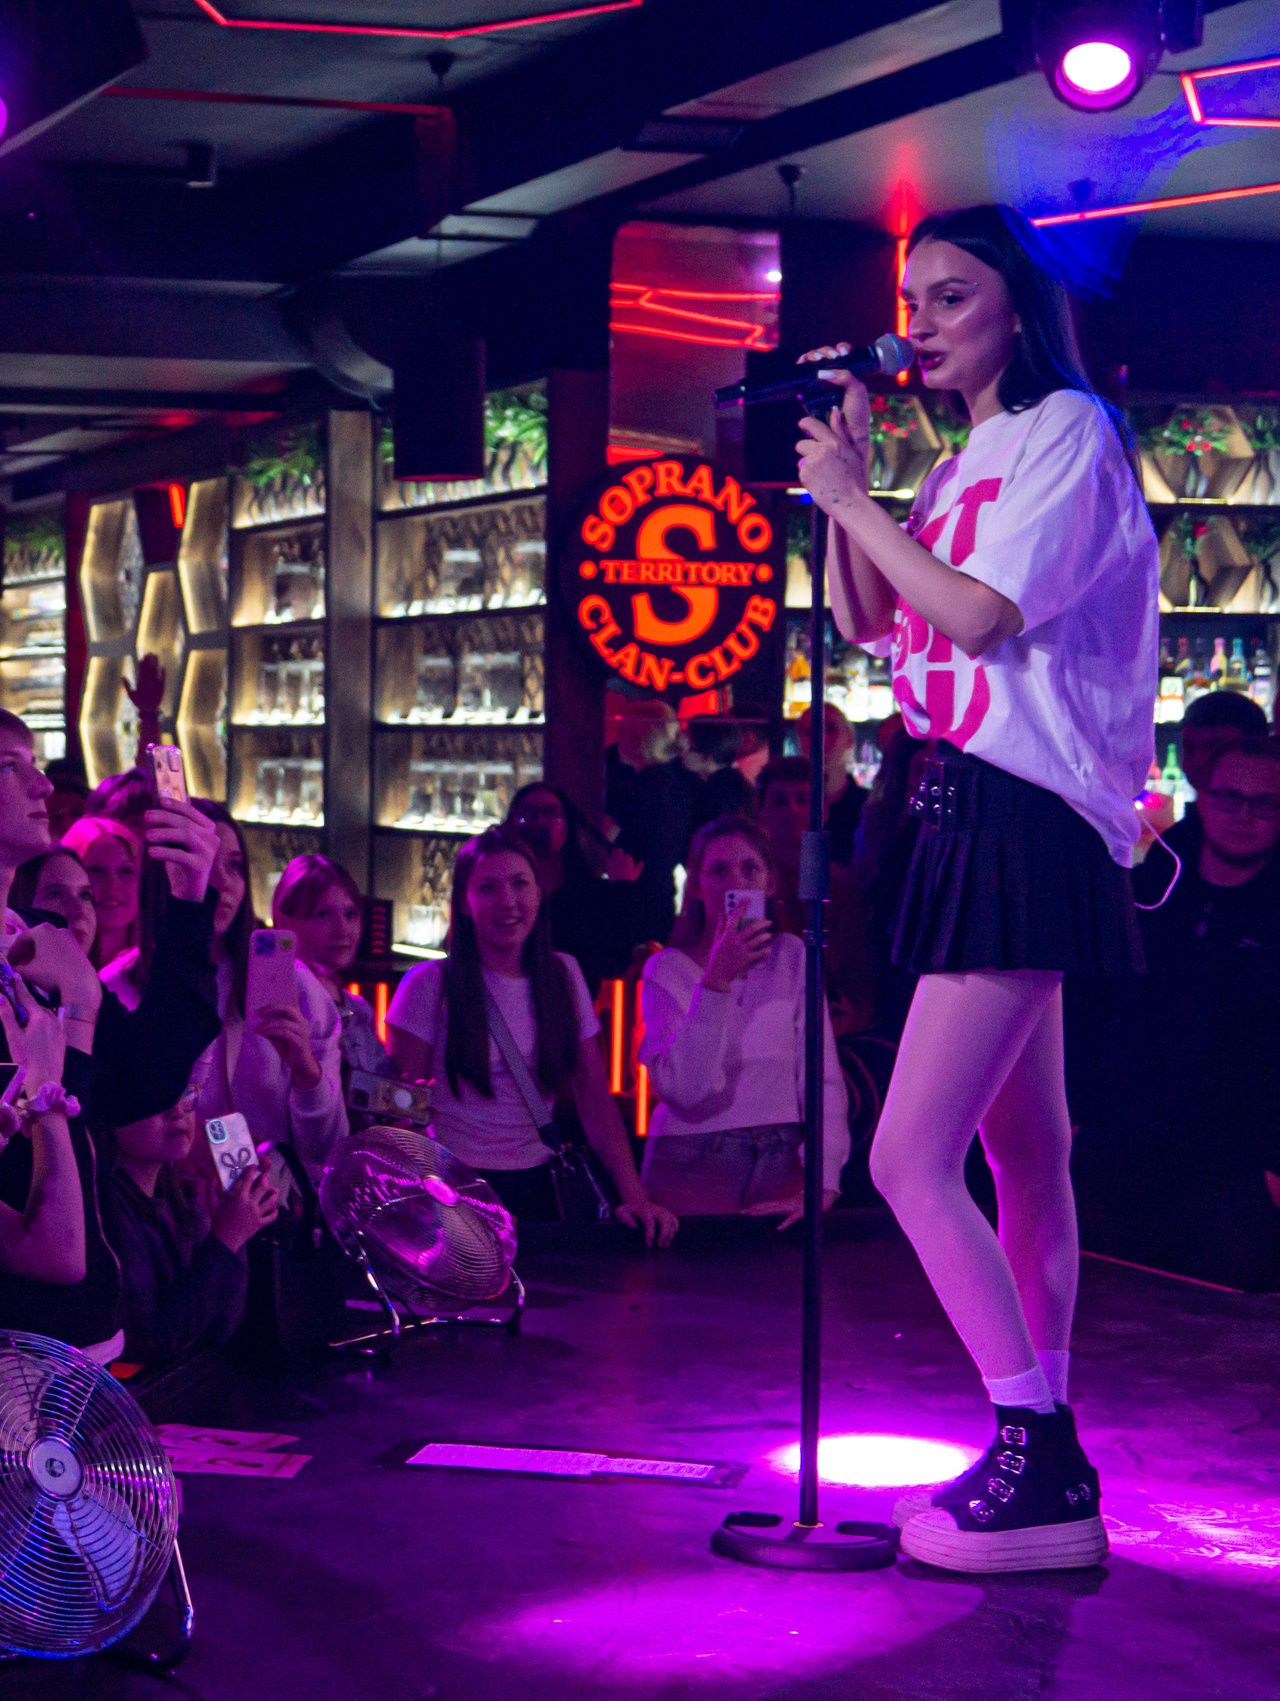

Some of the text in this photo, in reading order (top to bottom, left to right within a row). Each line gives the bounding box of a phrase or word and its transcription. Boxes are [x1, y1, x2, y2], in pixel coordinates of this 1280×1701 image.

[581, 460, 772, 552] SOPRANO
[599, 559, 756, 586] TERRITORY
[578, 594, 776, 691] CLAN-CLUB
